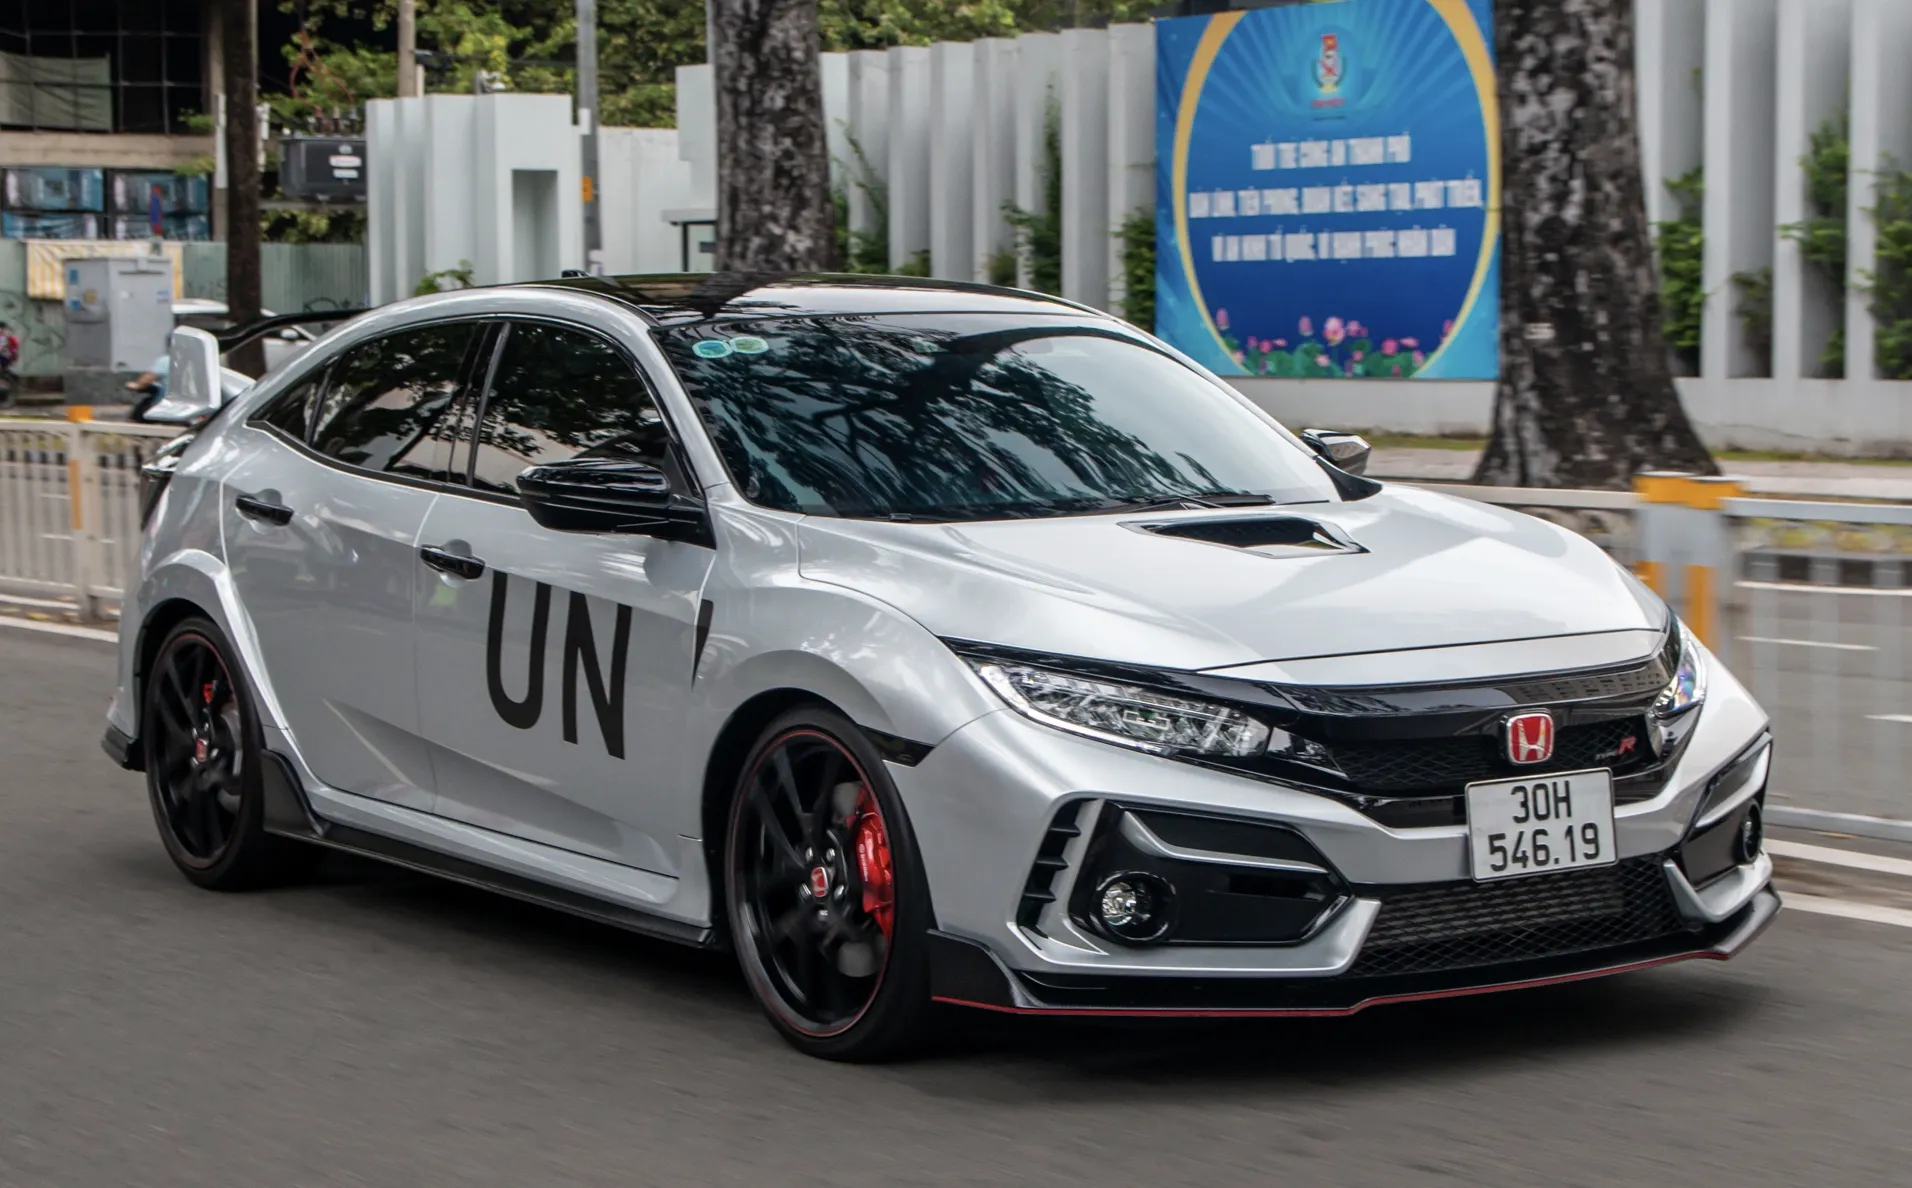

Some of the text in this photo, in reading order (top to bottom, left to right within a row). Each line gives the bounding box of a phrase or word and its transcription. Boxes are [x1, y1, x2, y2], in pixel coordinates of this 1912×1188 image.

[486, 570, 633, 760] UN
[1617, 735, 1638, 756] R
[1510, 780, 1572, 824] 30H
[1488, 822, 1600, 872] 546.19
